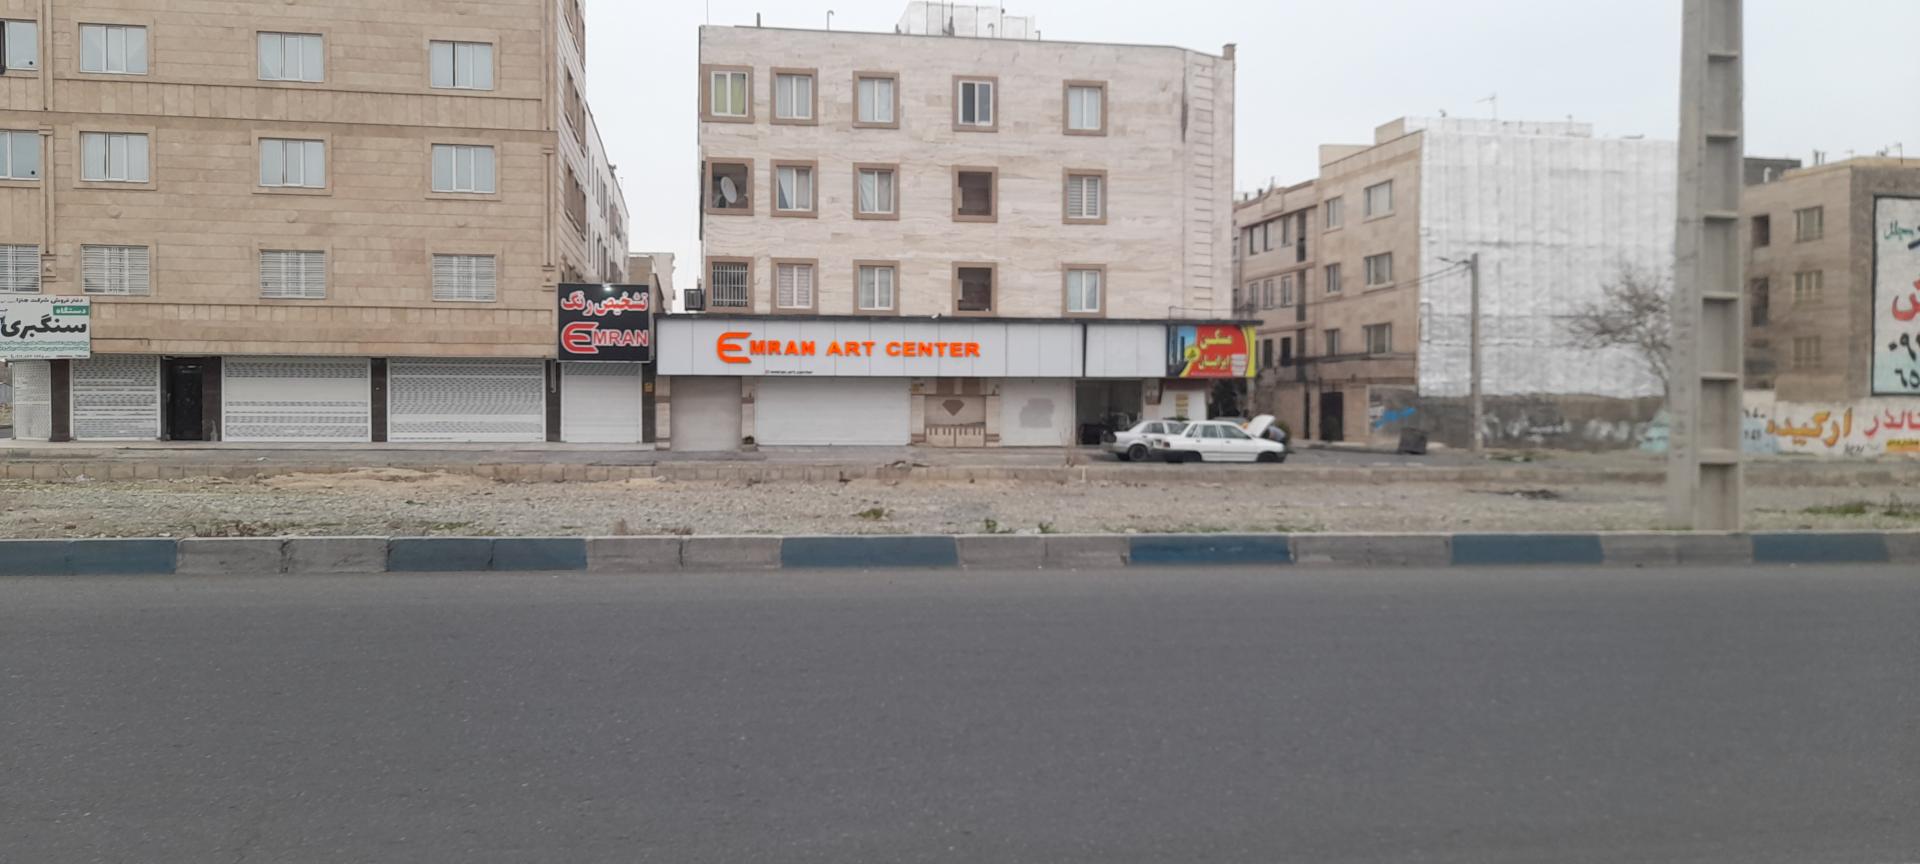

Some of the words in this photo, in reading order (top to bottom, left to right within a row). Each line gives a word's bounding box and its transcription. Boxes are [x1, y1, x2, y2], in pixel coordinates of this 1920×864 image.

[56, 306, 86, 314] دستگاه
[561, 290, 594, 317] رنگ
[593, 291, 649, 317] تشخیص
[1, 314, 87, 339] سنگبری
[561, 320, 649, 354] EMRAN
[1199, 329, 1233, 349] مسکن
[825, 340, 875, 357] ART
[886, 341, 981, 358] CENTER
